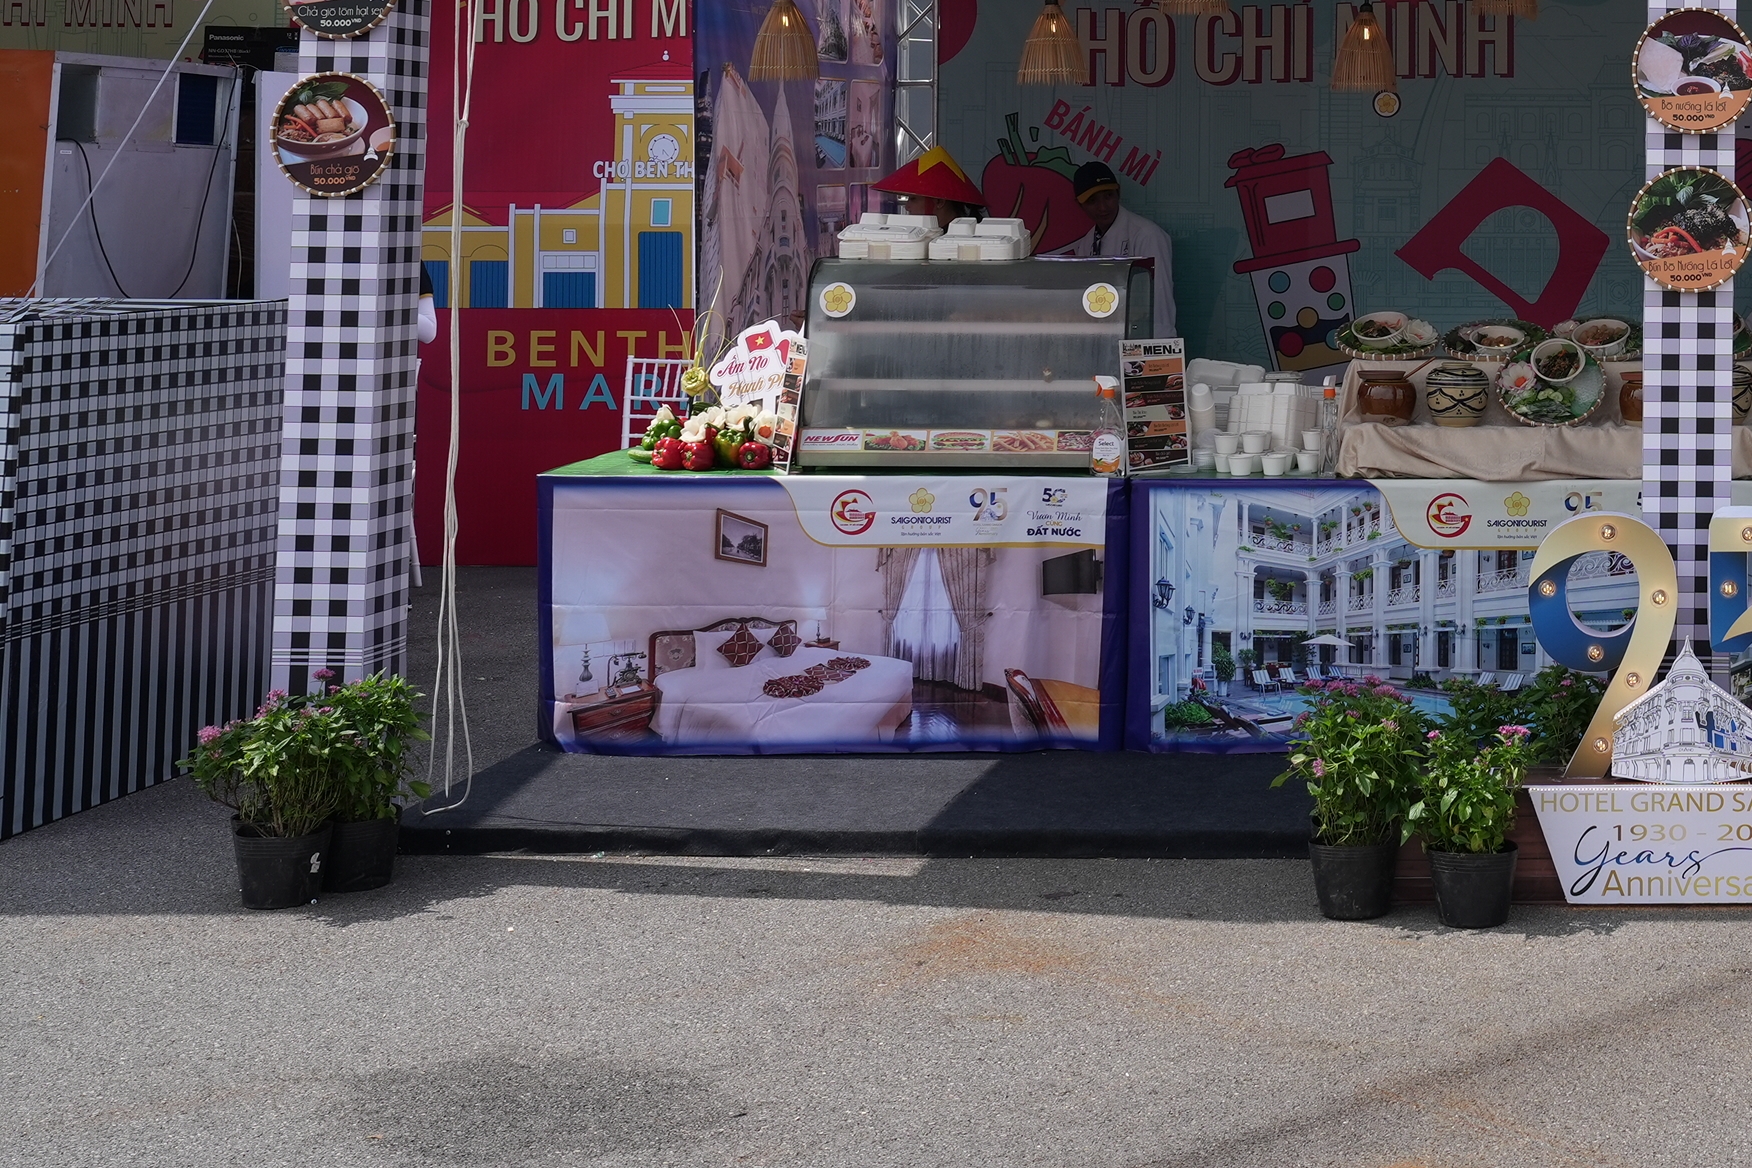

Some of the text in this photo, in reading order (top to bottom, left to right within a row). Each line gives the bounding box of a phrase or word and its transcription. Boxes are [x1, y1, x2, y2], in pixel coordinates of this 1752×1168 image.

[298, 5, 318, 17] Chả
[209, 33, 245, 41] Panasonic
[1043, 98, 1162, 187] BÁNH MÌ
[592, 155, 668, 182] CHỢ BẾN
[1648, 261, 1661, 272] Bún
[486, 330, 605, 368] BEN
[748, 355, 768, 371] No
[891, 516, 952, 524] SAIGONTOURIST
[1487, 519, 1547, 527] SAIGONTOURIST
[1027, 527, 1081, 537] ĐẤT NƯỚC
[1540, 792, 1623, 813] HOTEL
[1630, 792, 1725, 813] GRAND
[1613, 823, 1688, 842] 1930
